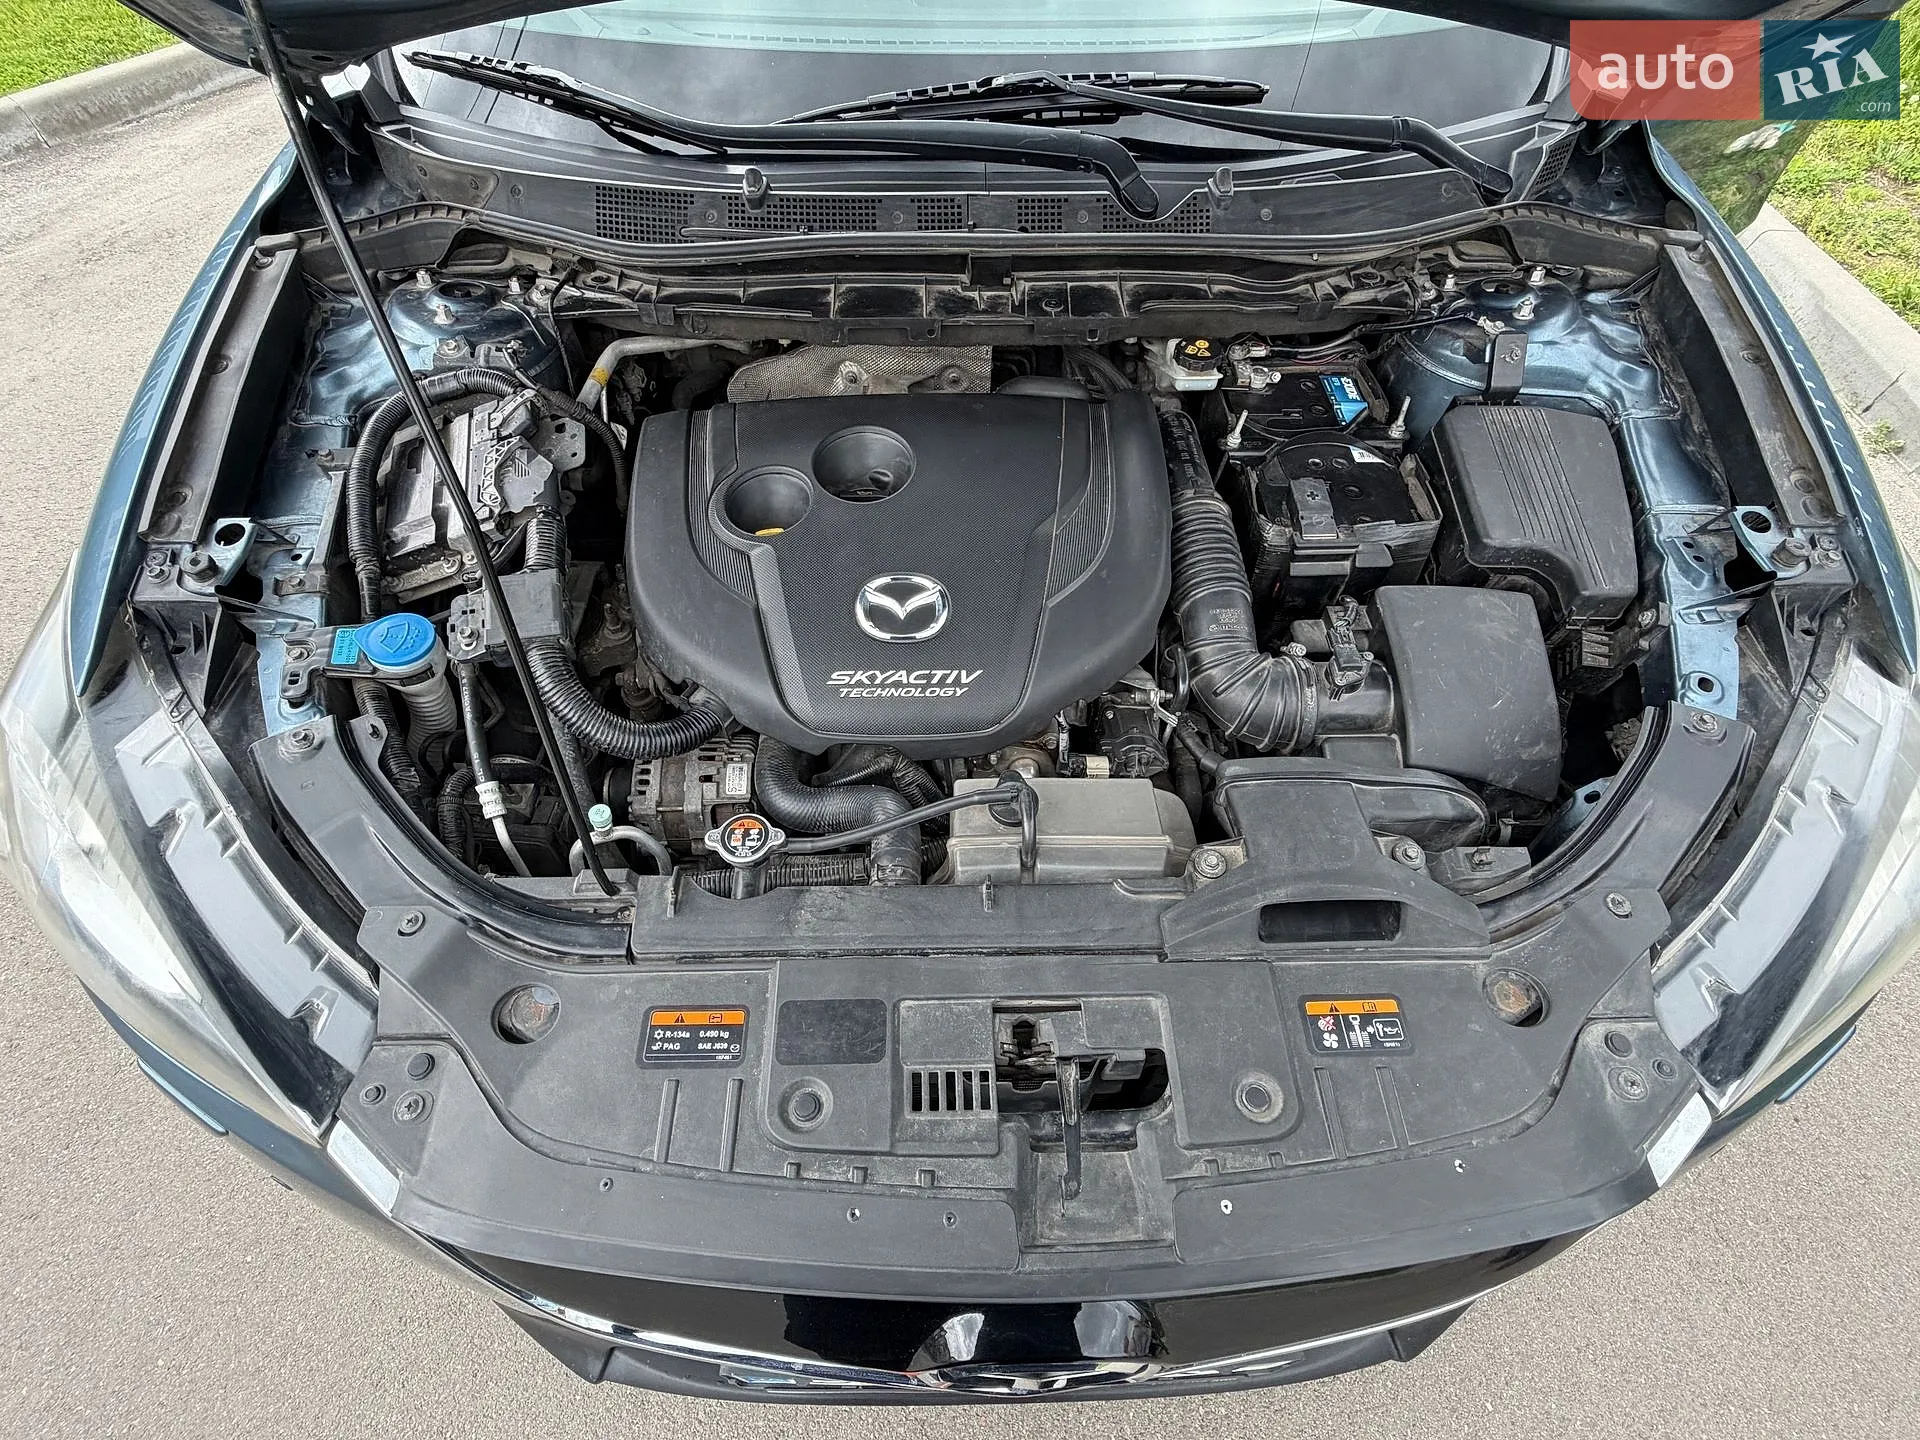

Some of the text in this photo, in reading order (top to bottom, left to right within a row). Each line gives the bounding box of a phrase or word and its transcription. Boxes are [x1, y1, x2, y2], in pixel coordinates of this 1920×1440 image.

[1340, 377, 1361, 401] EXIDE
[825, 669, 984, 685] SKYACTIV
[839, 687, 969, 698] TECHNOLOGY
[664, 1030, 690, 1039] R-134a
[719, 1030, 730, 1040] kg
[662, 1042, 681, 1051] PAG
